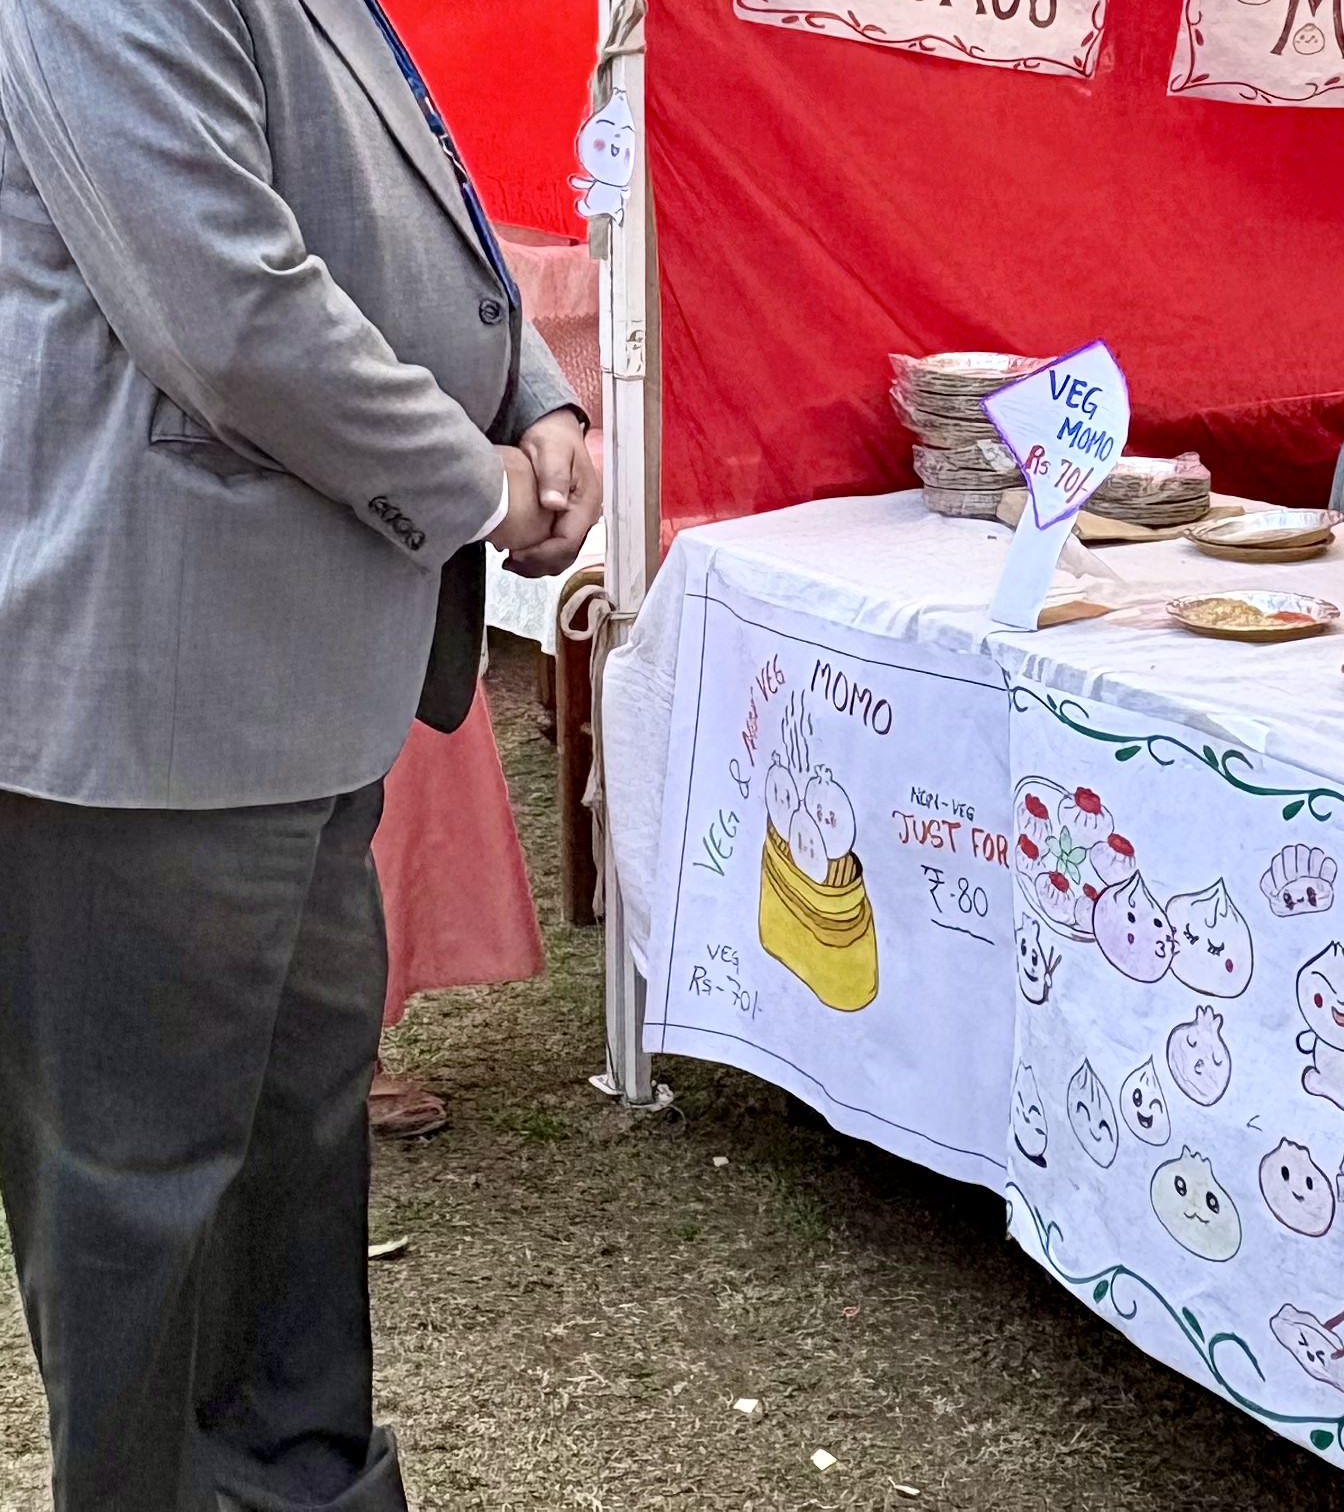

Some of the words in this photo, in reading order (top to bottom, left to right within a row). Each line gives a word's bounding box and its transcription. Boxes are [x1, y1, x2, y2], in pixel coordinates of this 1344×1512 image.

[1049, 369, 1104, 420] VEG
[1056, 416, 1114, 462] MOMO
[1025, 444, 1052, 476] Rs
[1054, 458, 1095, 504] 70/-
[811, 658, 892, 735] MOMO
[692, 808, 740, 876] VEG
[755, 653, 786, 702] VEG
[892, 810, 962, 853] JUST
[972, 828, 1010, 869] FOR
[706, 944, 740, 976] VEG
